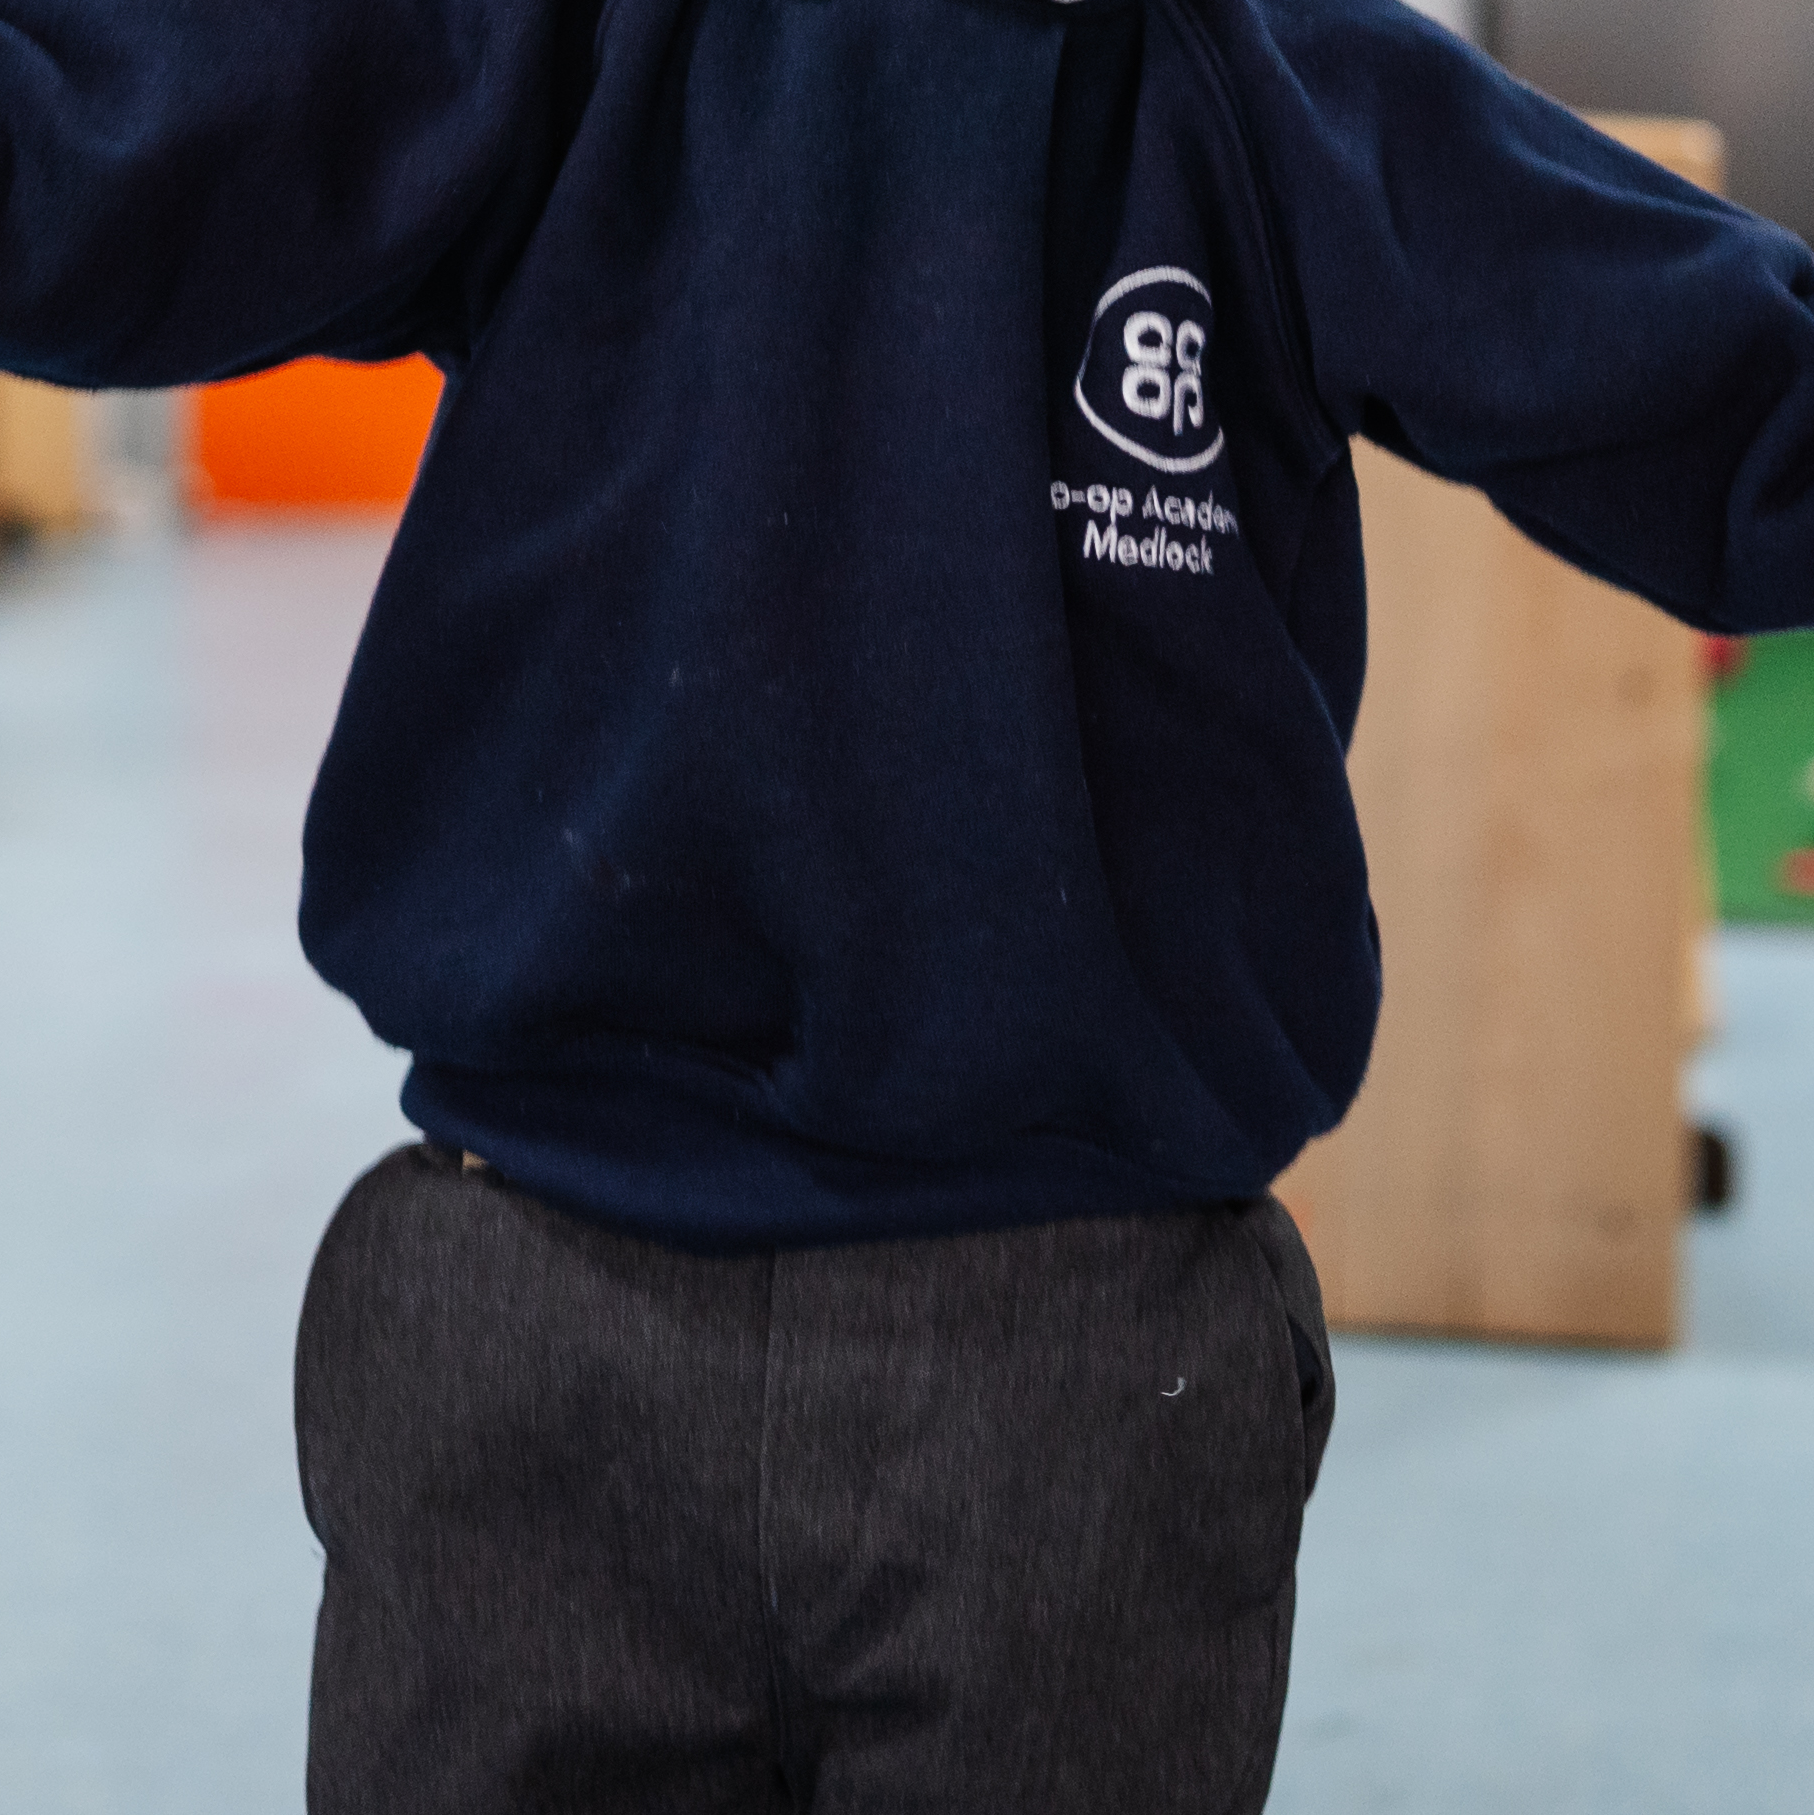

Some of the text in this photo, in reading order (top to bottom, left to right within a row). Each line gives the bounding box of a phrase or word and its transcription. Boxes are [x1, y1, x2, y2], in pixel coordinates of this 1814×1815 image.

[1050, 480, 1239, 538] o-op Academ
[1083, 519, 1214, 575] Medlock
